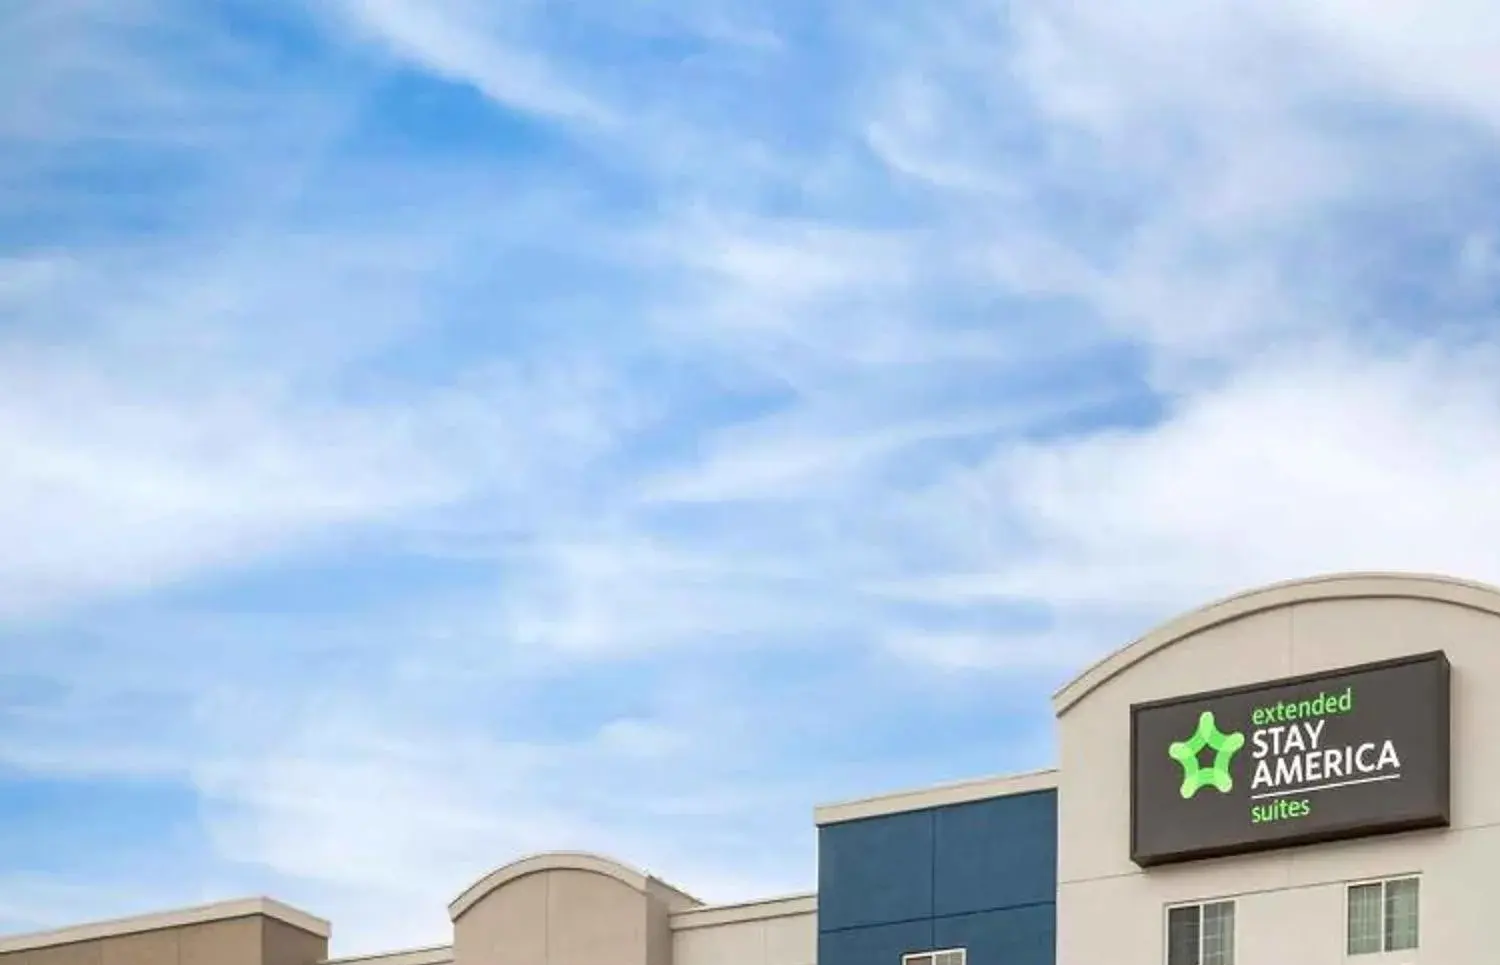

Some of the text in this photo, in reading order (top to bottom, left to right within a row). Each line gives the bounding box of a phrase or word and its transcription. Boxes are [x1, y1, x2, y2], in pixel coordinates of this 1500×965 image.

[1252, 688, 1352, 726] extended
[1252, 720, 1325, 759] STAY
[1252, 740, 1400, 789] AMERICA
[1251, 798, 1311, 824] suites
